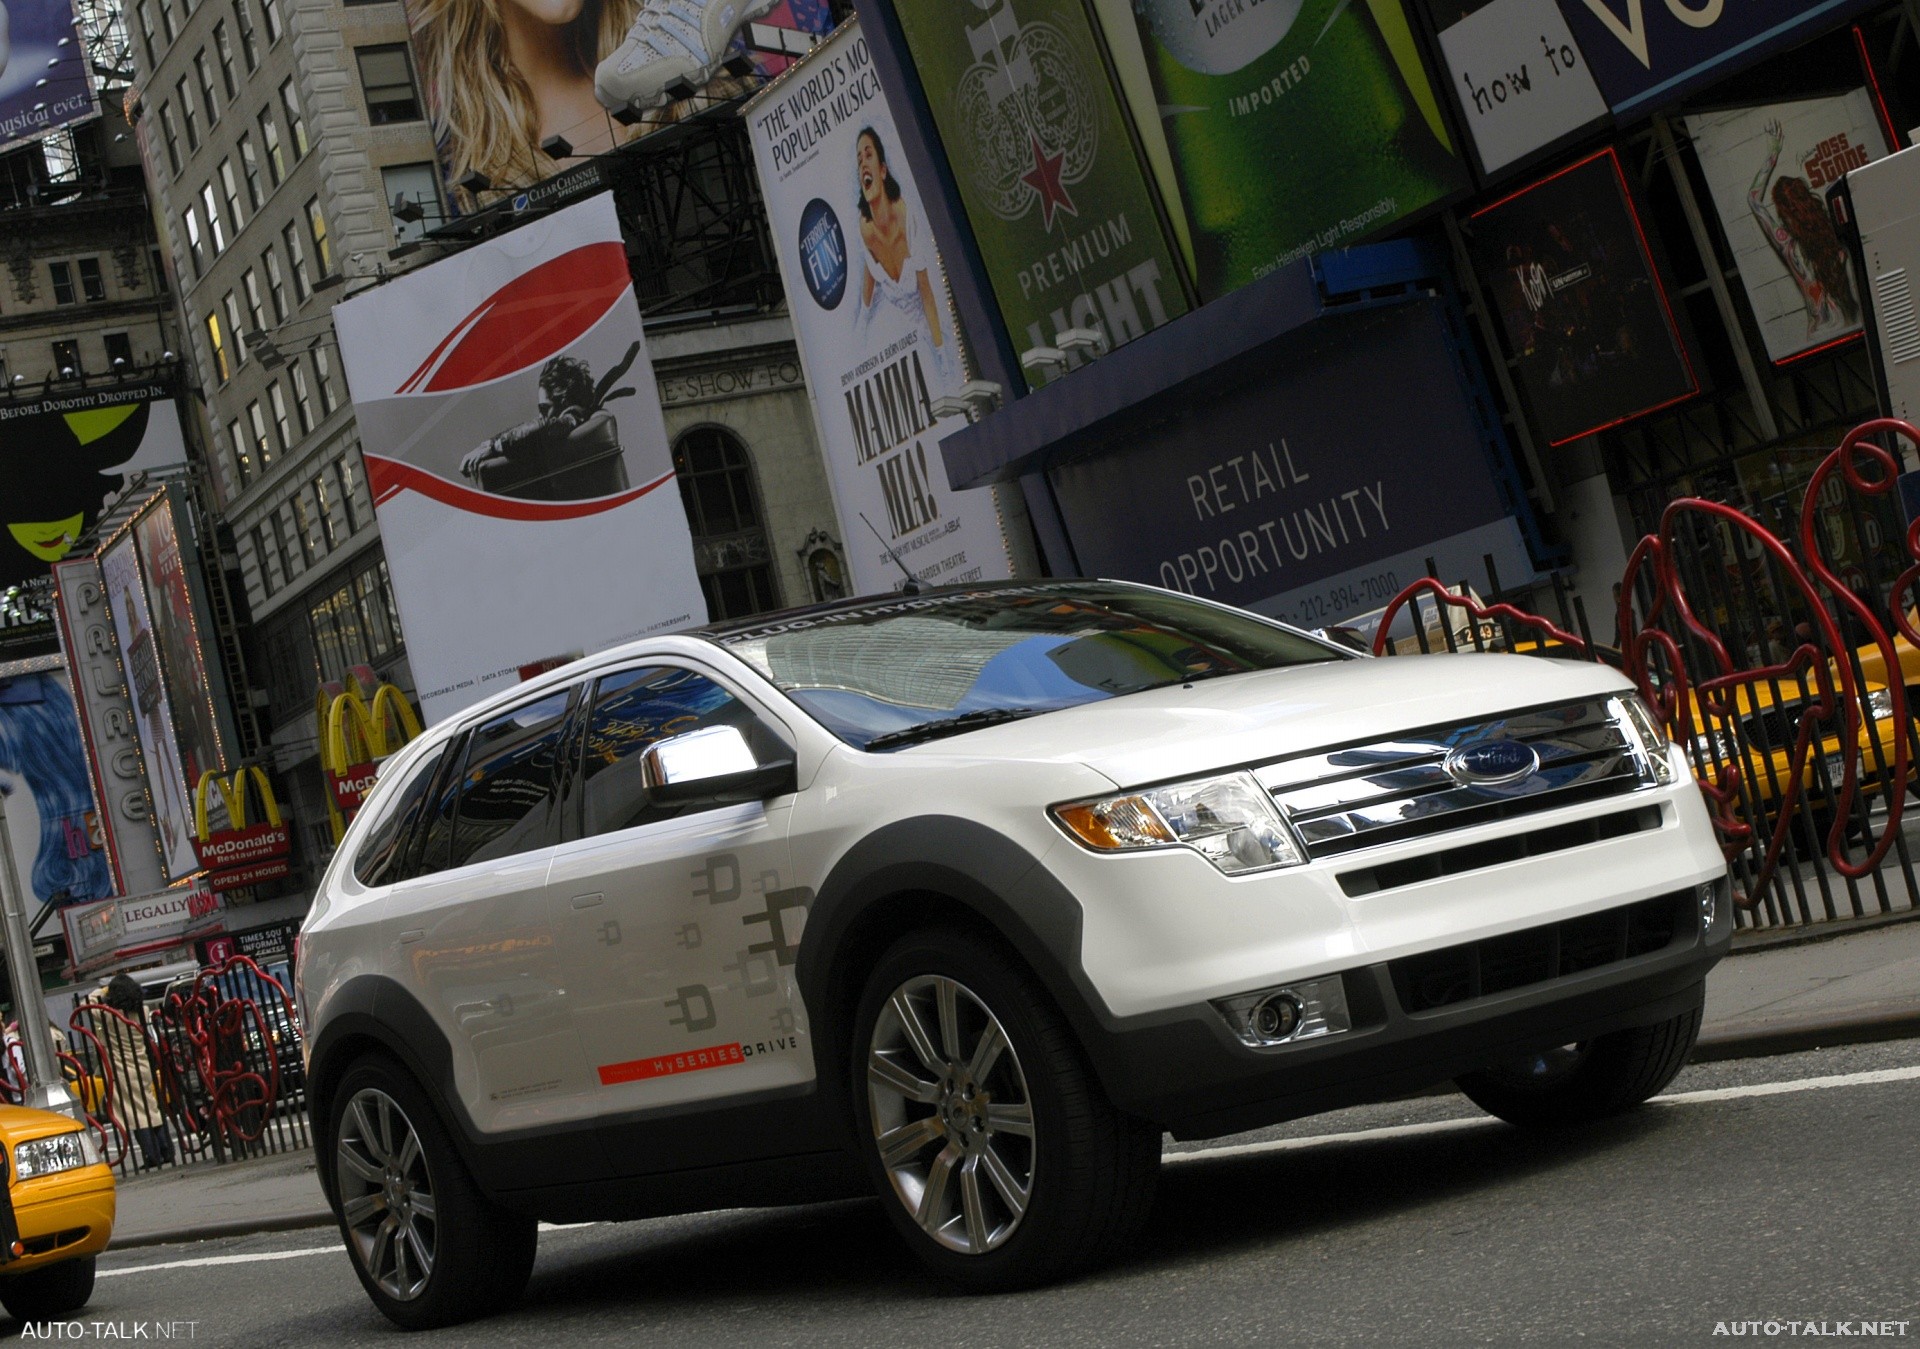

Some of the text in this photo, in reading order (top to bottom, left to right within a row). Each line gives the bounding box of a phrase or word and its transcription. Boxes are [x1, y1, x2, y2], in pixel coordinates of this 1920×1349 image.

[788, 57, 846, 121] WORLD'S
[846, 38, 870, 76] MO
[1228, 54, 1311, 117] IMPORTED
[1464, 35, 1576, 115] how to
[53, 93, 87, 116] ever.
[772, 108, 832, 171] POPULAR
[831, 68, 882, 126] MUSICA
[1814, 132, 1850, 160] JOSS
[1275, 238, 1317, 267] Heineken
[1316, 224, 1341, 248] Light
[1339, 196, 1398, 236] Responsibly.
[1017, 212, 1133, 300] PREMIUM
[1024, 257, 1170, 384] LIGHT
[686, 368, 754, 398] SHOW
[0, 386, 166, 420] BEFORE DOROTHY DROPPED IN.
[844, 350, 938, 466] MAMMA
[876, 440, 938, 540] MIA!
[1187, 438, 1310, 521] RETAIL
[1159, 481, 1390, 596] OPPORTUNITY
[940, 551, 967, 573] THEATRE
[959, 566, 983, 584] STREET
[1299, 571, 1400, 622] 212-894-7000
[646, 613, 691, 632] PARTNERSHIPS
[718, 611, 863, 646] PLUG-IN
[1464, 624, 1492, 643] 249
[456, 679, 474, 692] MEDIA
[481, 672, 497, 682] DATA
[76, 582, 148, 822] PALACE
[201, 832, 286, 858] McDonald's
[216, 846, 273, 864] Restaurant
[213, 864, 288, 887] OPEN 24 HOURS
[125, 899, 188, 924] LEGALLY
[239, 932, 265, 945] TIMES
[243, 937, 283, 953] INFORMAT
[743, 1036, 797, 1057] DRIVE
